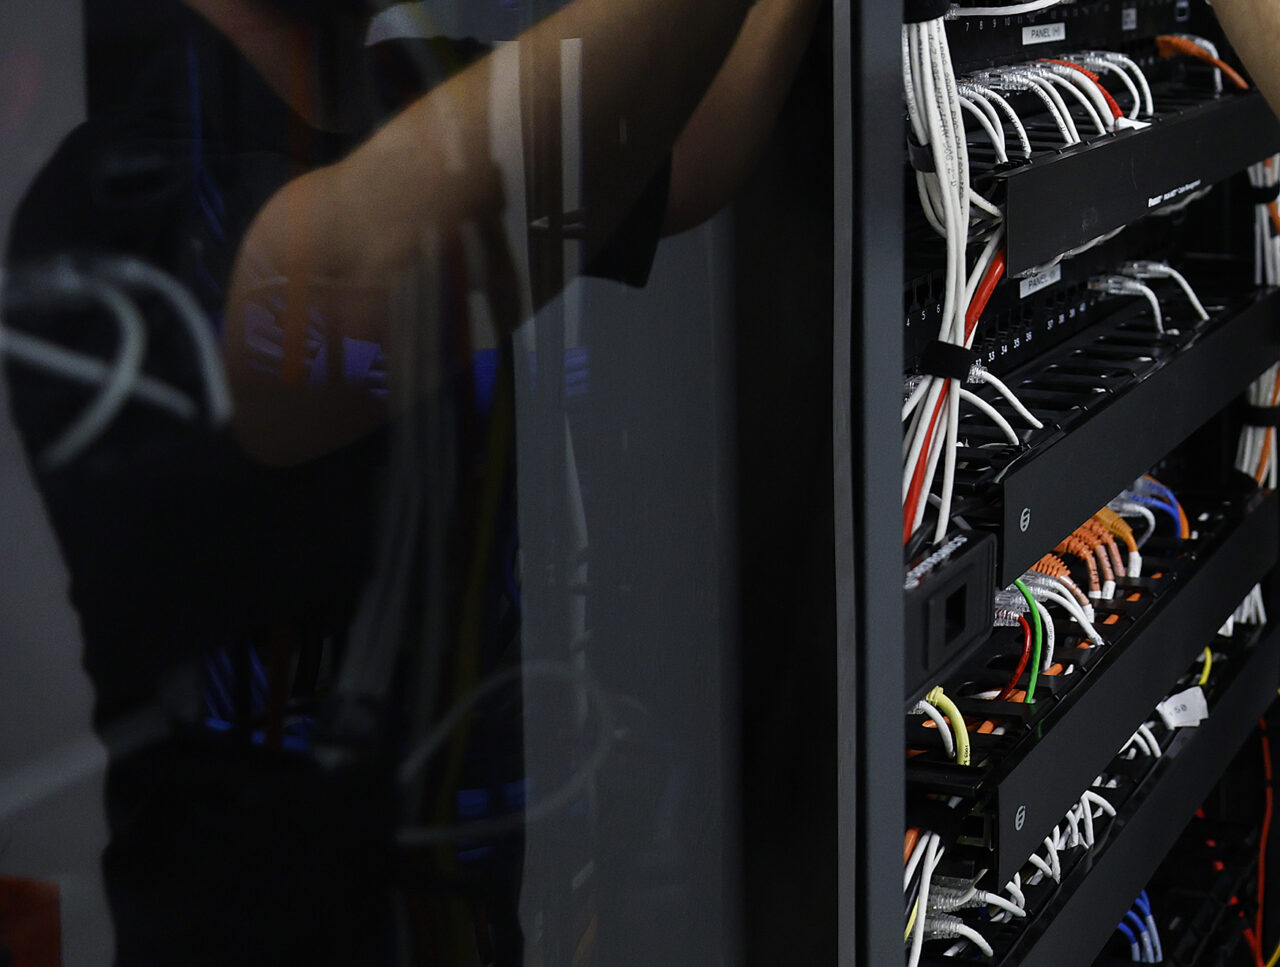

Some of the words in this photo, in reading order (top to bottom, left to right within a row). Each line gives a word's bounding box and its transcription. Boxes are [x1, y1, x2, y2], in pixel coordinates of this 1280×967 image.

[965, 22, 970, 32] 7
[979, 20, 984, 31] 8
[992, 18, 997, 29] 9
[1031, 27, 1051, 39] PANEL
[906, 317, 911, 327] 4
[921, 310, 926, 321] 5
[936, 303, 941, 314] 6
[988, 351, 995, 362] 33
[1001, 344, 1008, 355] 34
[1013, 337, 1020, 349] 35
[1025, 331, 1032, 342] 36
